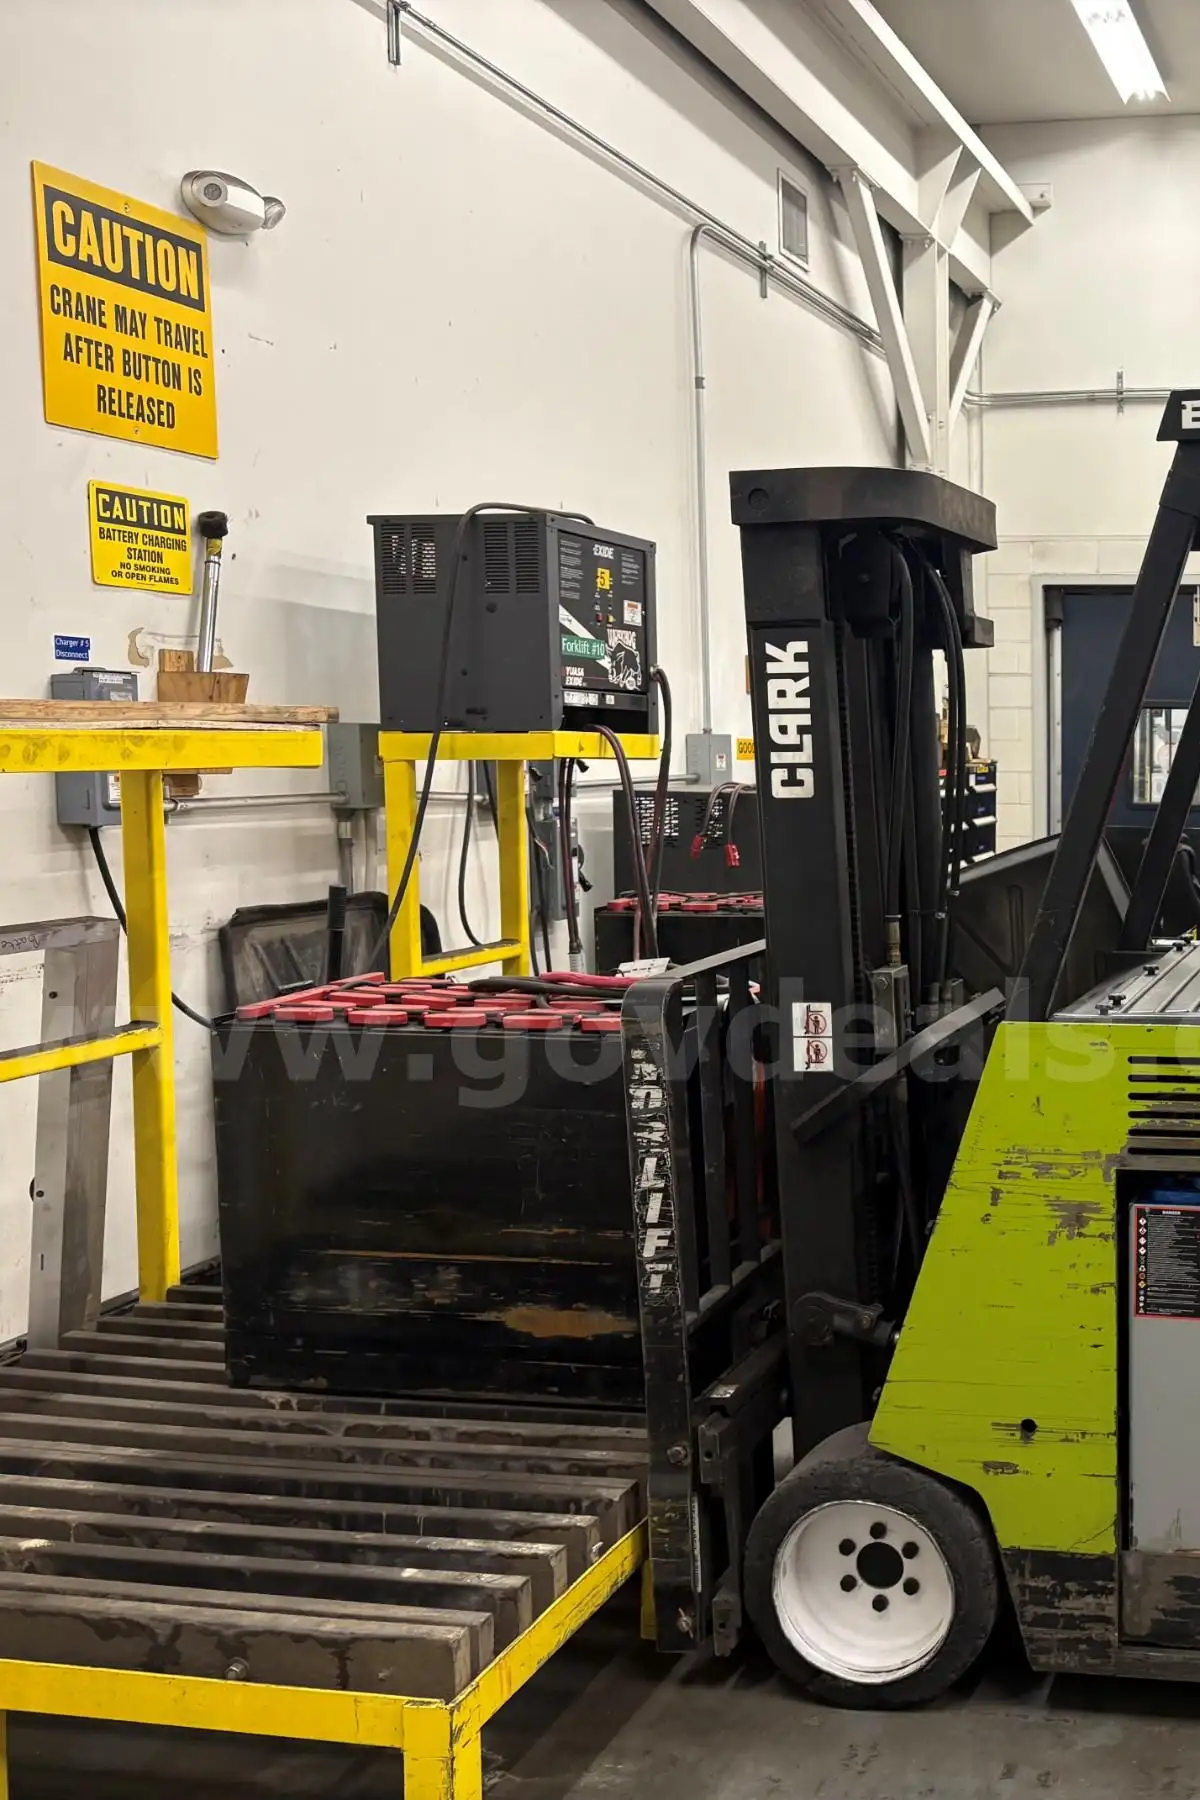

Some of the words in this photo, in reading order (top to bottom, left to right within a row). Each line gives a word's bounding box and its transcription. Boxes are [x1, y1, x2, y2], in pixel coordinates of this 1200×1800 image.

[52, 200, 199, 300] CAUTION
[50, 284, 107, 329] CRANE
[115, 303, 147, 340] MAY
[154, 316, 208, 359] TRAVEL
[63, 332, 114, 373] AFTER
[122, 348, 182, 391] BUTTON
[188, 367, 202, 396] IS
[97, 384, 175, 429] RELEASED
[98, 493, 185, 531] CAUTION
[99, 526, 139, 546] BATTERY
[142, 533, 187, 551] CHARGING
[127, 547, 163, 564] STATION
[593, 544, 614, 560] EXIDE
[120, 562, 132, 570] NO
[133, 564, 171, 575] SMOKING
[111, 570, 123, 579] OR
[125, 572, 147, 582] OPEN
[149, 575, 179, 586] FLAMES
[599, 571, 606, 587] 5
[55, 638, 78, 648] Charger
[562, 638, 590, 655] Forklift
[591, 642, 605, 656] #10
[56, 649, 88, 659] Disconnect
[765, 641, 814, 798] CLARK
[739, 742, 756, 753] GOO
